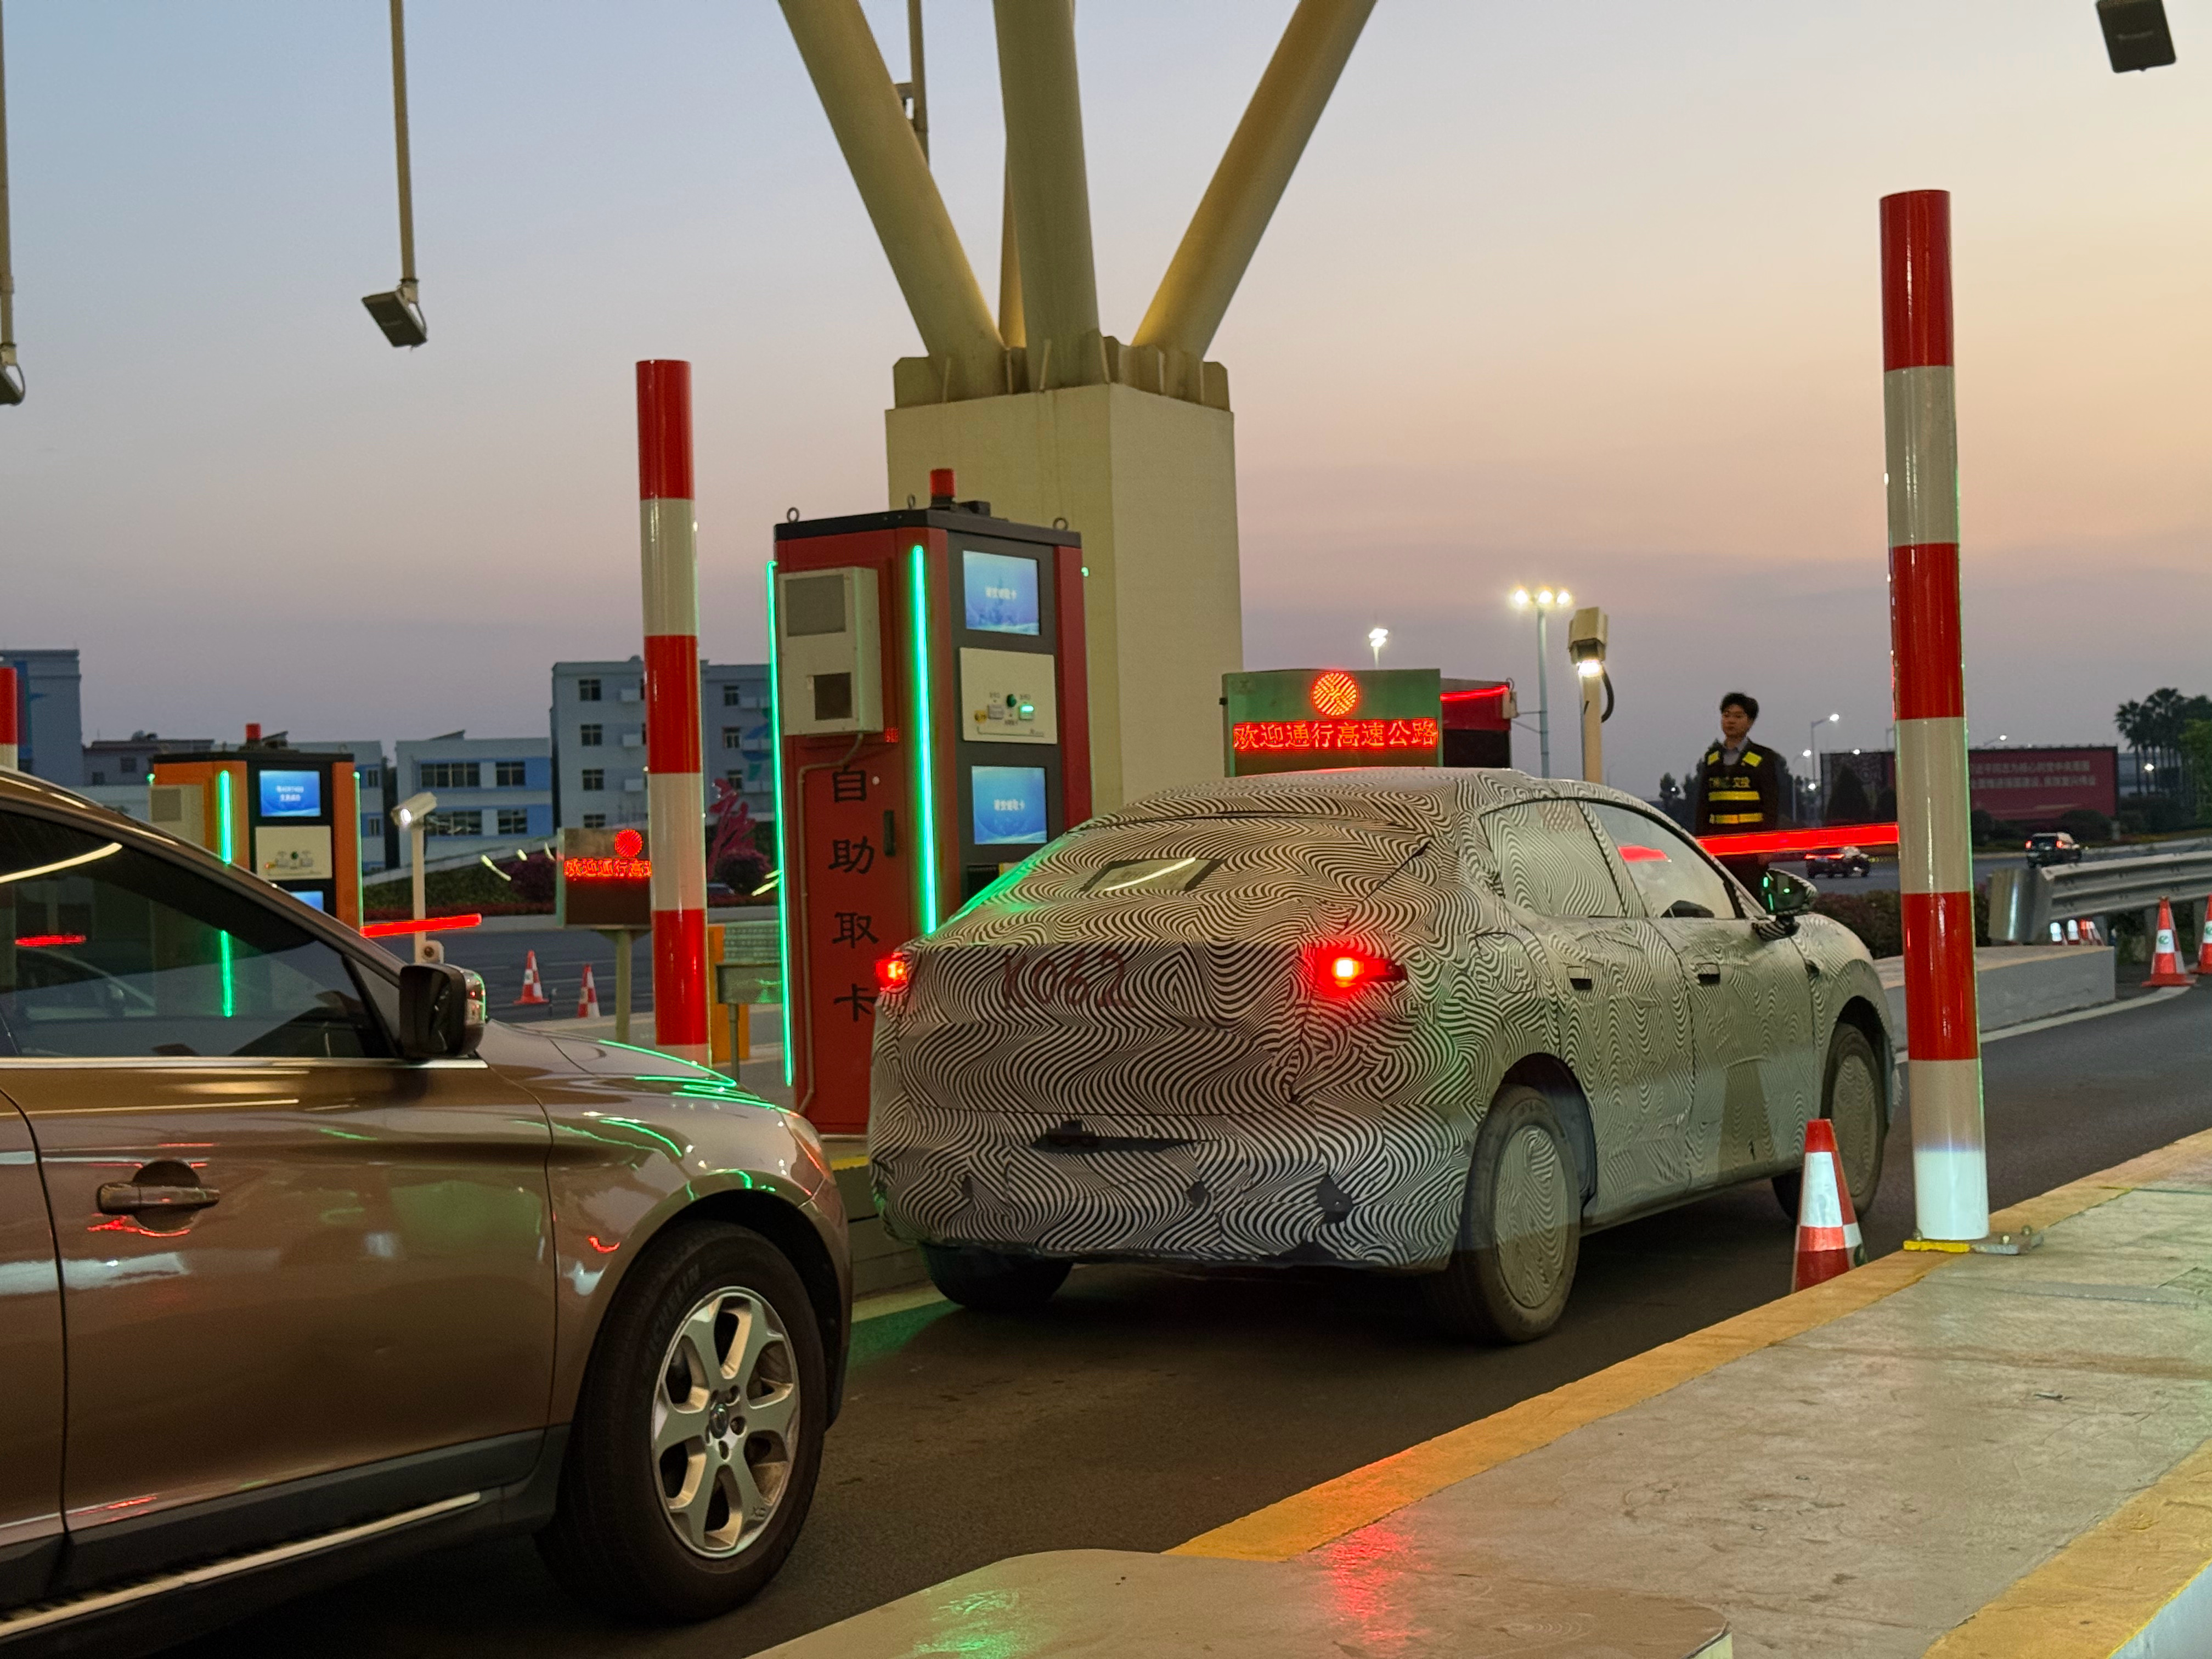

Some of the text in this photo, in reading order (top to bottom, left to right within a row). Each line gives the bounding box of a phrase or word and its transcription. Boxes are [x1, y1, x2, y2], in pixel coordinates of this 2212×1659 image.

[1234, 721, 1437, 748] 欢迎通行高速公路
[828, 765, 879, 1022] 自助取卡
